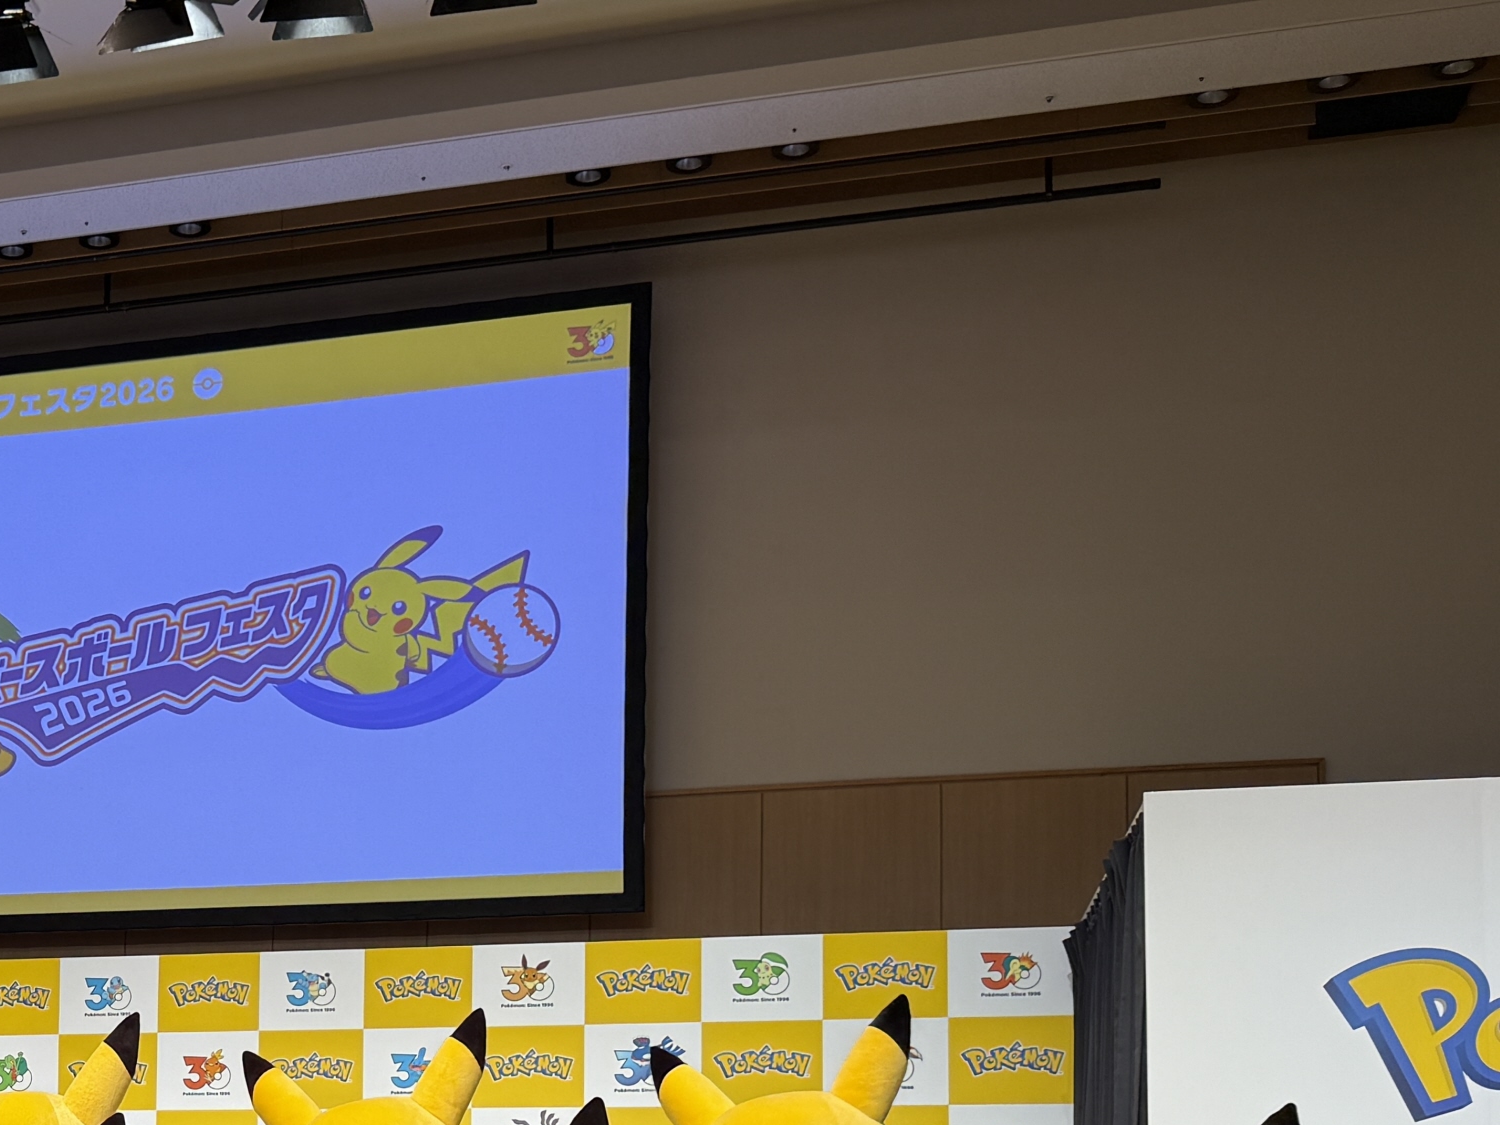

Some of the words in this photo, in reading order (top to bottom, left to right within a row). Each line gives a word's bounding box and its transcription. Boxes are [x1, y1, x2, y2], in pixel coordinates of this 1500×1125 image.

[33, 680, 132, 736] 2026
[374, 970, 462, 1002] Pokémon
[595, 964, 689, 997] Pokémon
[834, 957, 935, 991] Pokémon
[168, 976, 249, 1007] Pokémon
[485, 1049, 574, 1081] Pokémon
[713, 1045, 812, 1078] Pokémon
[961, 1042, 1065, 1076] Pokémon
